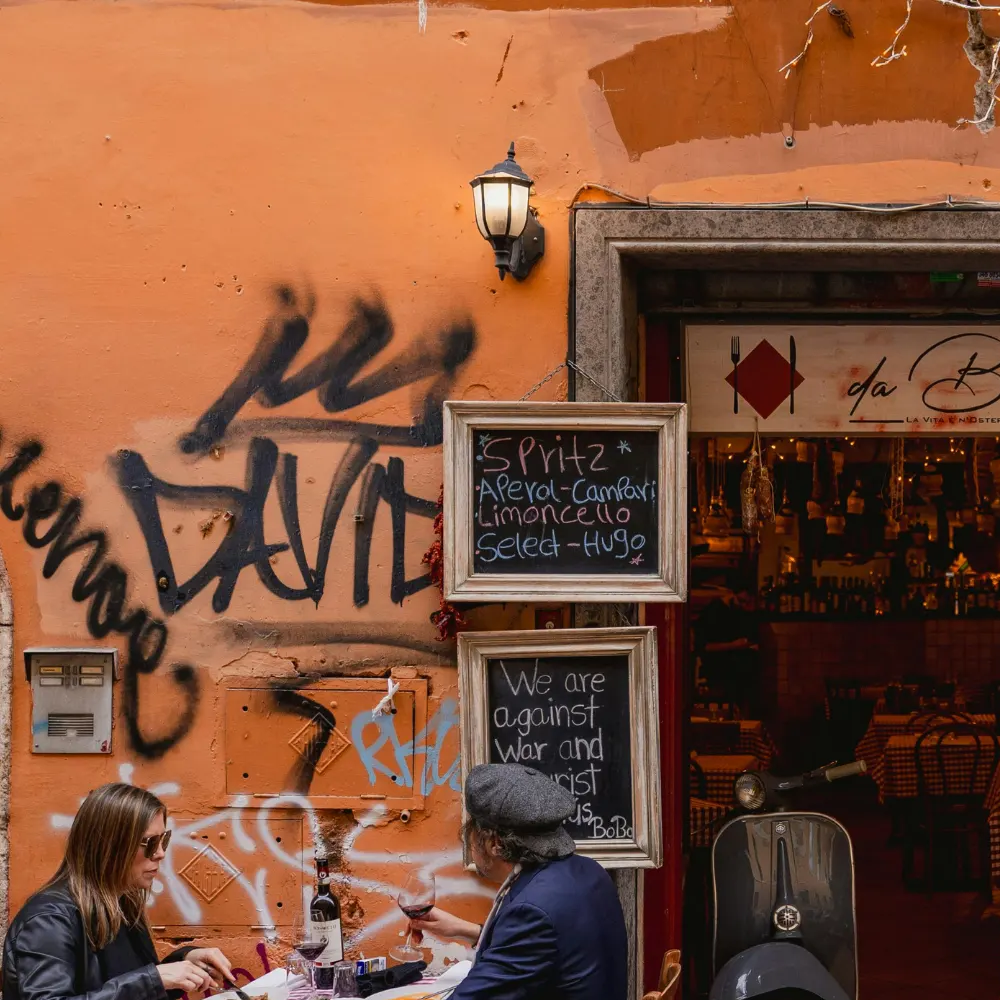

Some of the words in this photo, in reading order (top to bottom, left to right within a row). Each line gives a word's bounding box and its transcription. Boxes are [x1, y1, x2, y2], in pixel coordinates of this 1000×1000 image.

[847, 356, 897, 416] da
[477, 504, 631, 527] Limoncello
[477, 529, 560, 562] Select
[583, 528, 646, 559] Hugo
[500, 658, 552, 696] We
[564, 672, 606, 694] are
[494, 695, 601, 737] against
[559, 727, 604, 761] and
